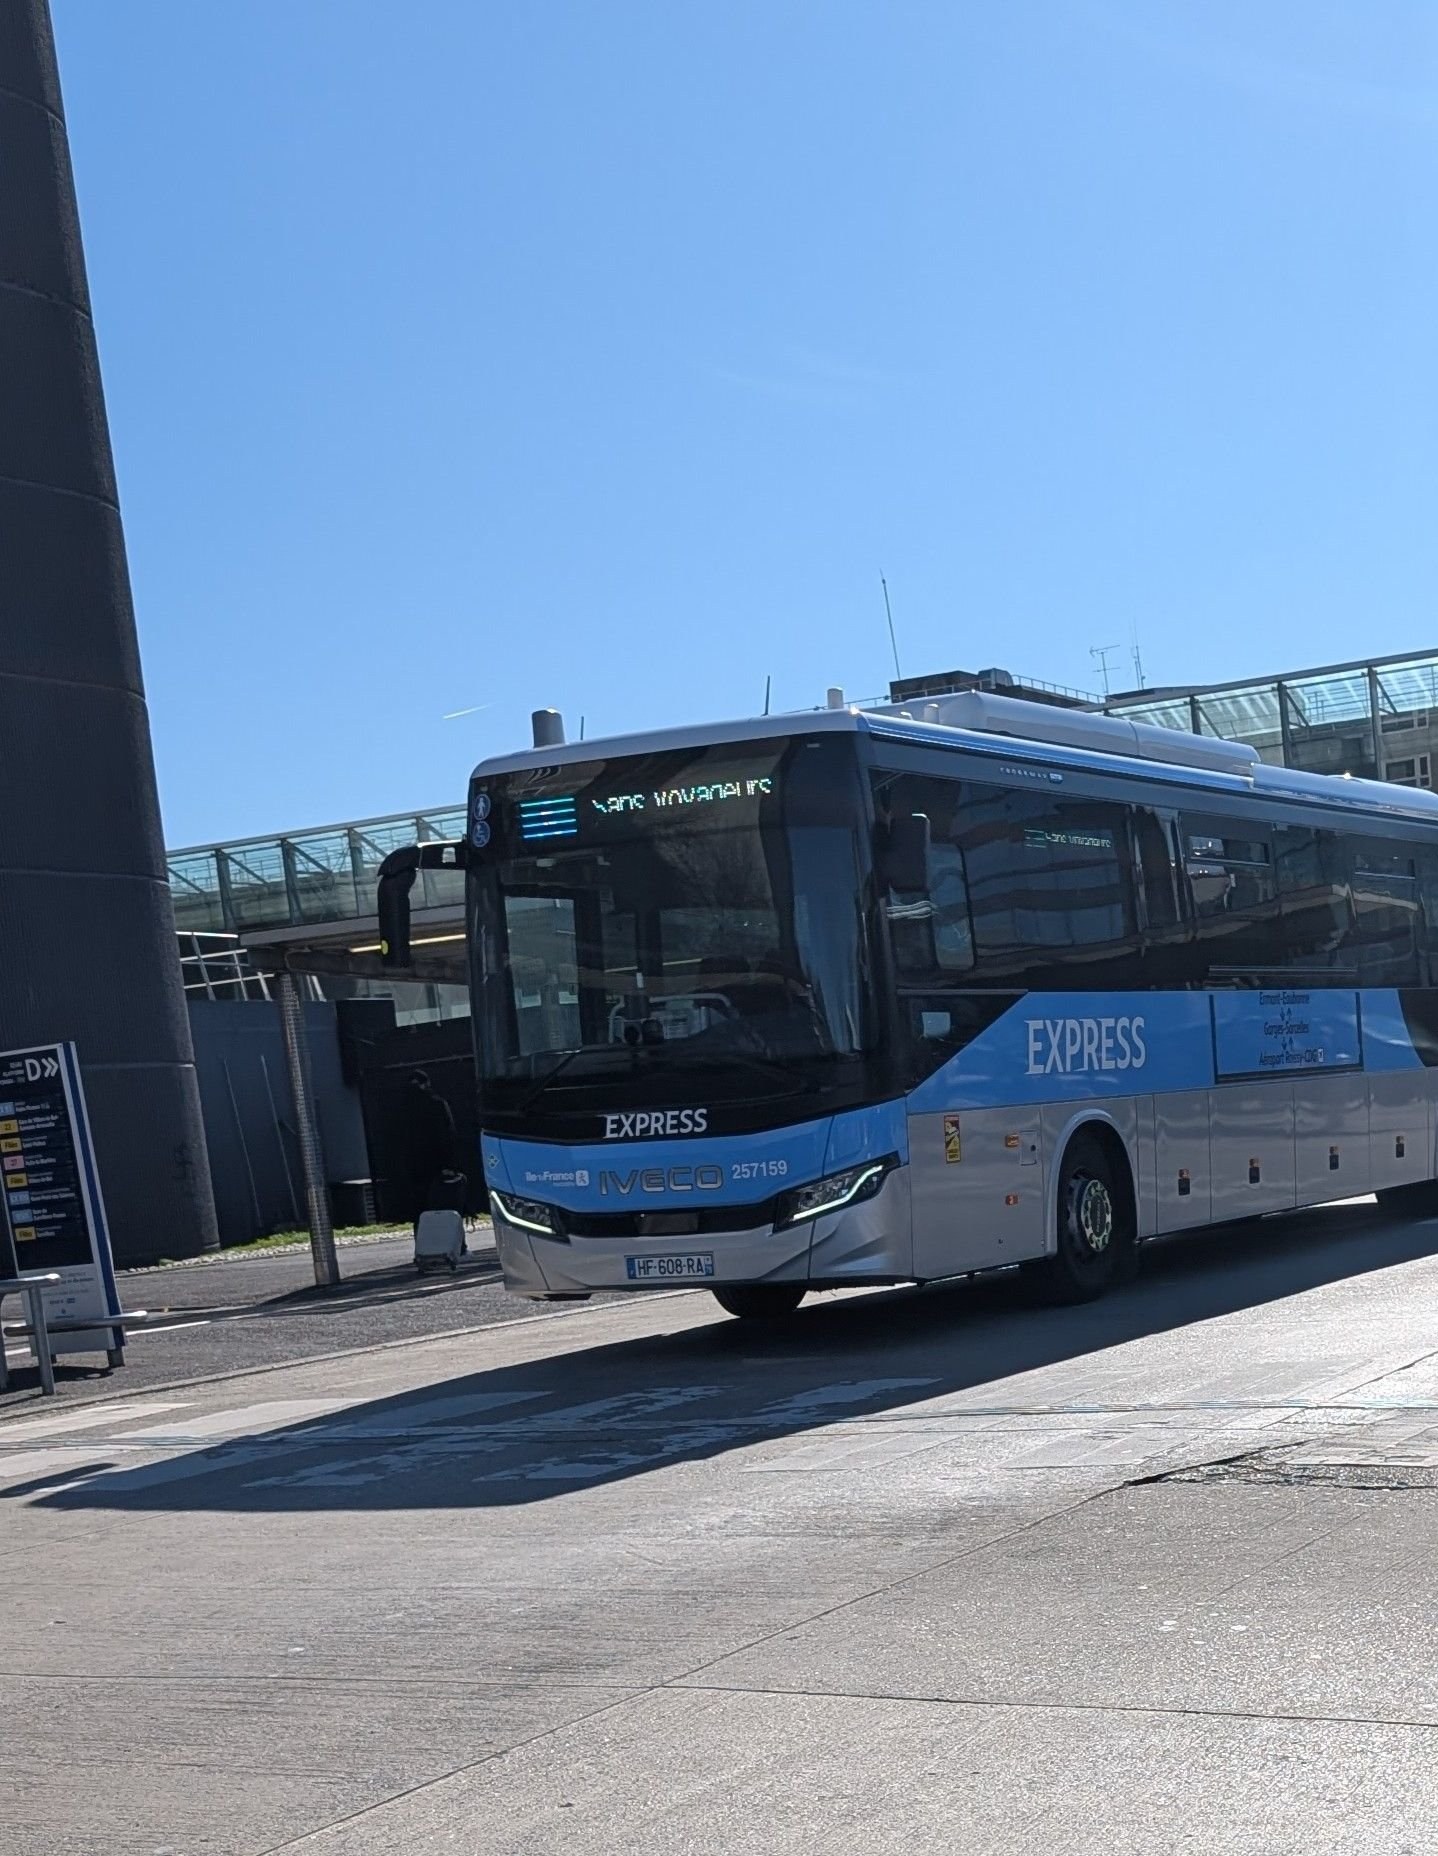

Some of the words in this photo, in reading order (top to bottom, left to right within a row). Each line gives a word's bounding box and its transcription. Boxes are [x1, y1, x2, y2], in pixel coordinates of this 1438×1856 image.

[1024, 1015, 1146, 1075] EXPRESS
[24, 1058, 42, 1082] D
[603, 1108, 708, 1140] EXPRESS
[600, 1165, 723, 1196] IVECO
[732, 1160, 788, 1180] 257159
[637, 1256, 705, 1276] HF-608-RA
